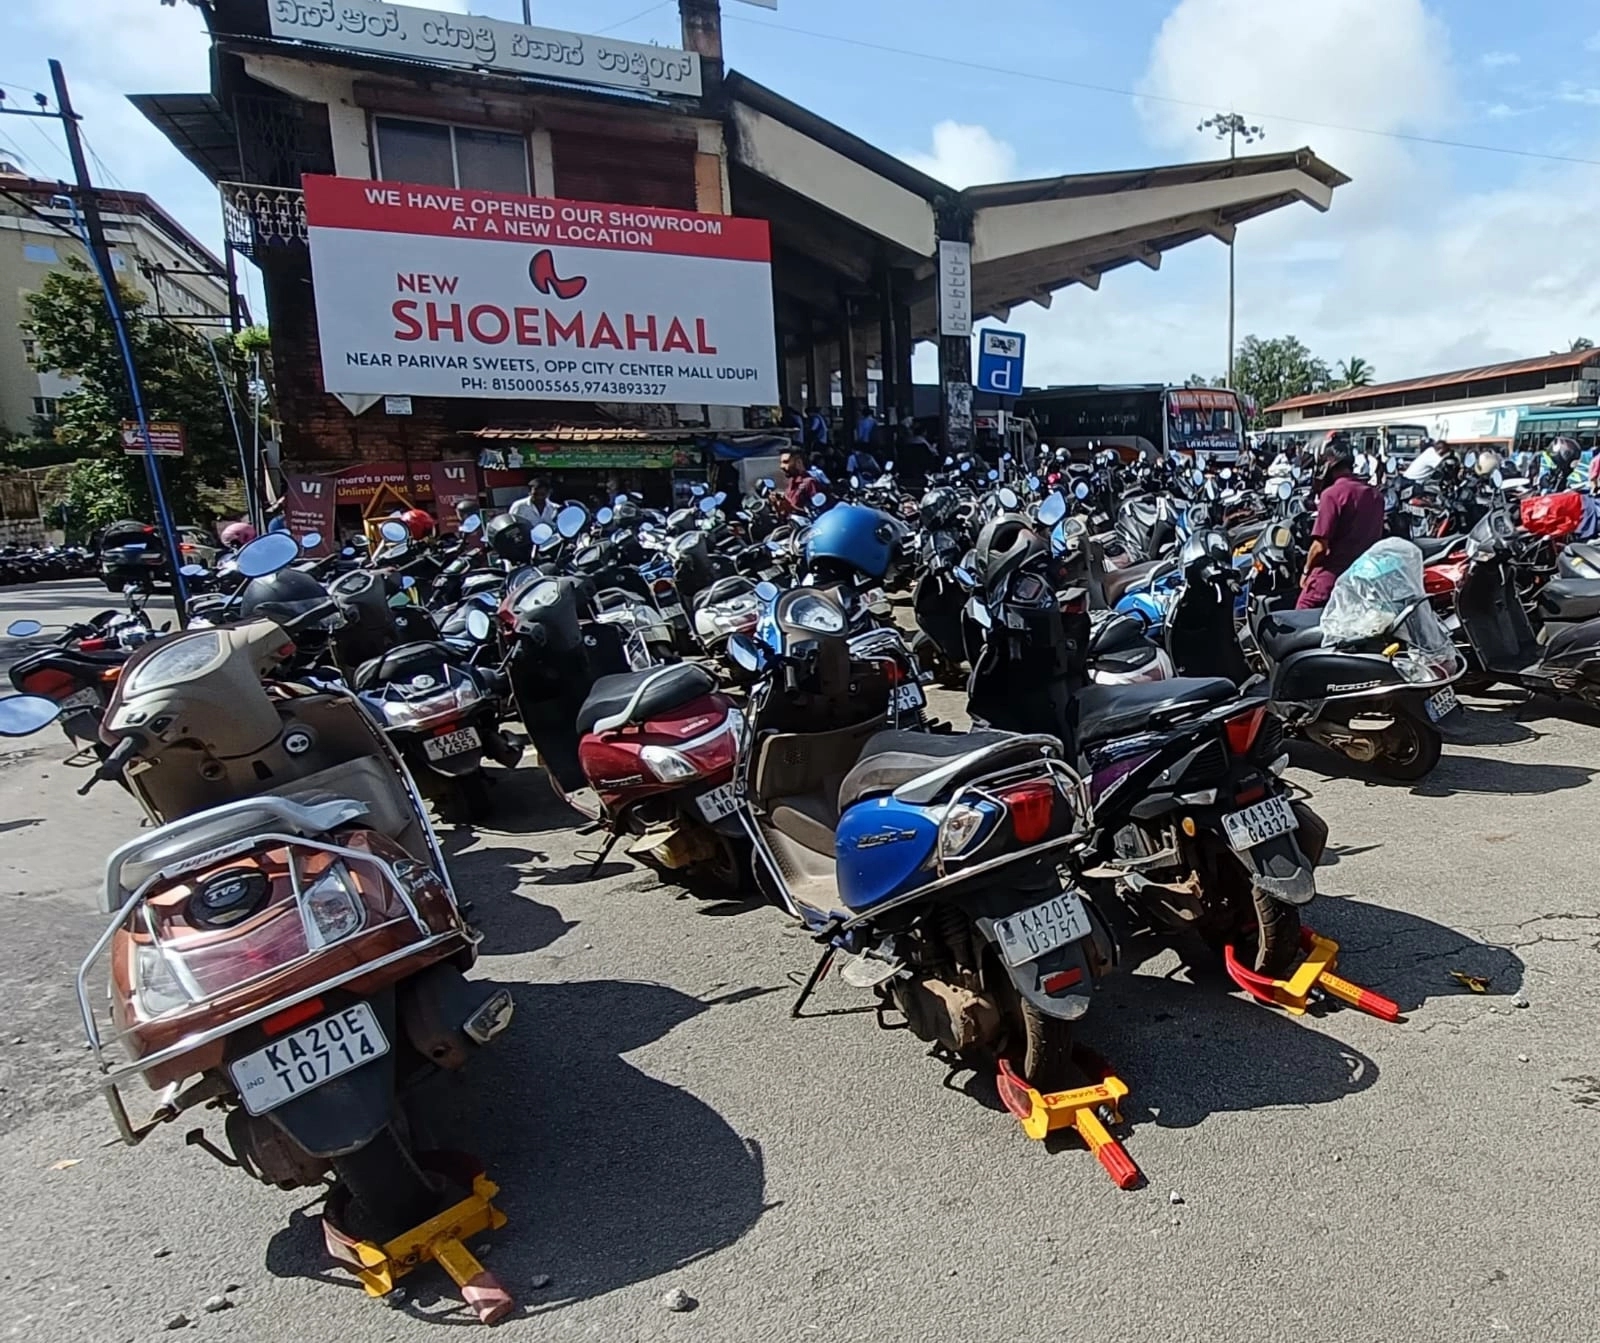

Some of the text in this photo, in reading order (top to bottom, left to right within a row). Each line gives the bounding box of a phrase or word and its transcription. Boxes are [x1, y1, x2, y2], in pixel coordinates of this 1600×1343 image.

[365, 188, 722, 235] WE HAVE OPENED OUR SHOWROOM
[452, 216, 653, 246] AT A NEW LOCATION
[397, 272, 459, 295] NEW
[391, 299, 718, 355] SHOEMAHAL
[346, 352, 758, 381] NEAR PARIVAR SWEETS, OPP CITY CENTER MALL UDUPI
[461, 377, 488, 390] PH:
[432, 728, 472, 748] KA20E
[1240, 798, 1284, 827] KA19H
[207, 883, 241, 901] TVS
[1019, 895, 1074, 934] KA20E
[265, 1009, 364, 1071] KA20E
[277, 1033, 374, 1093] T0714
